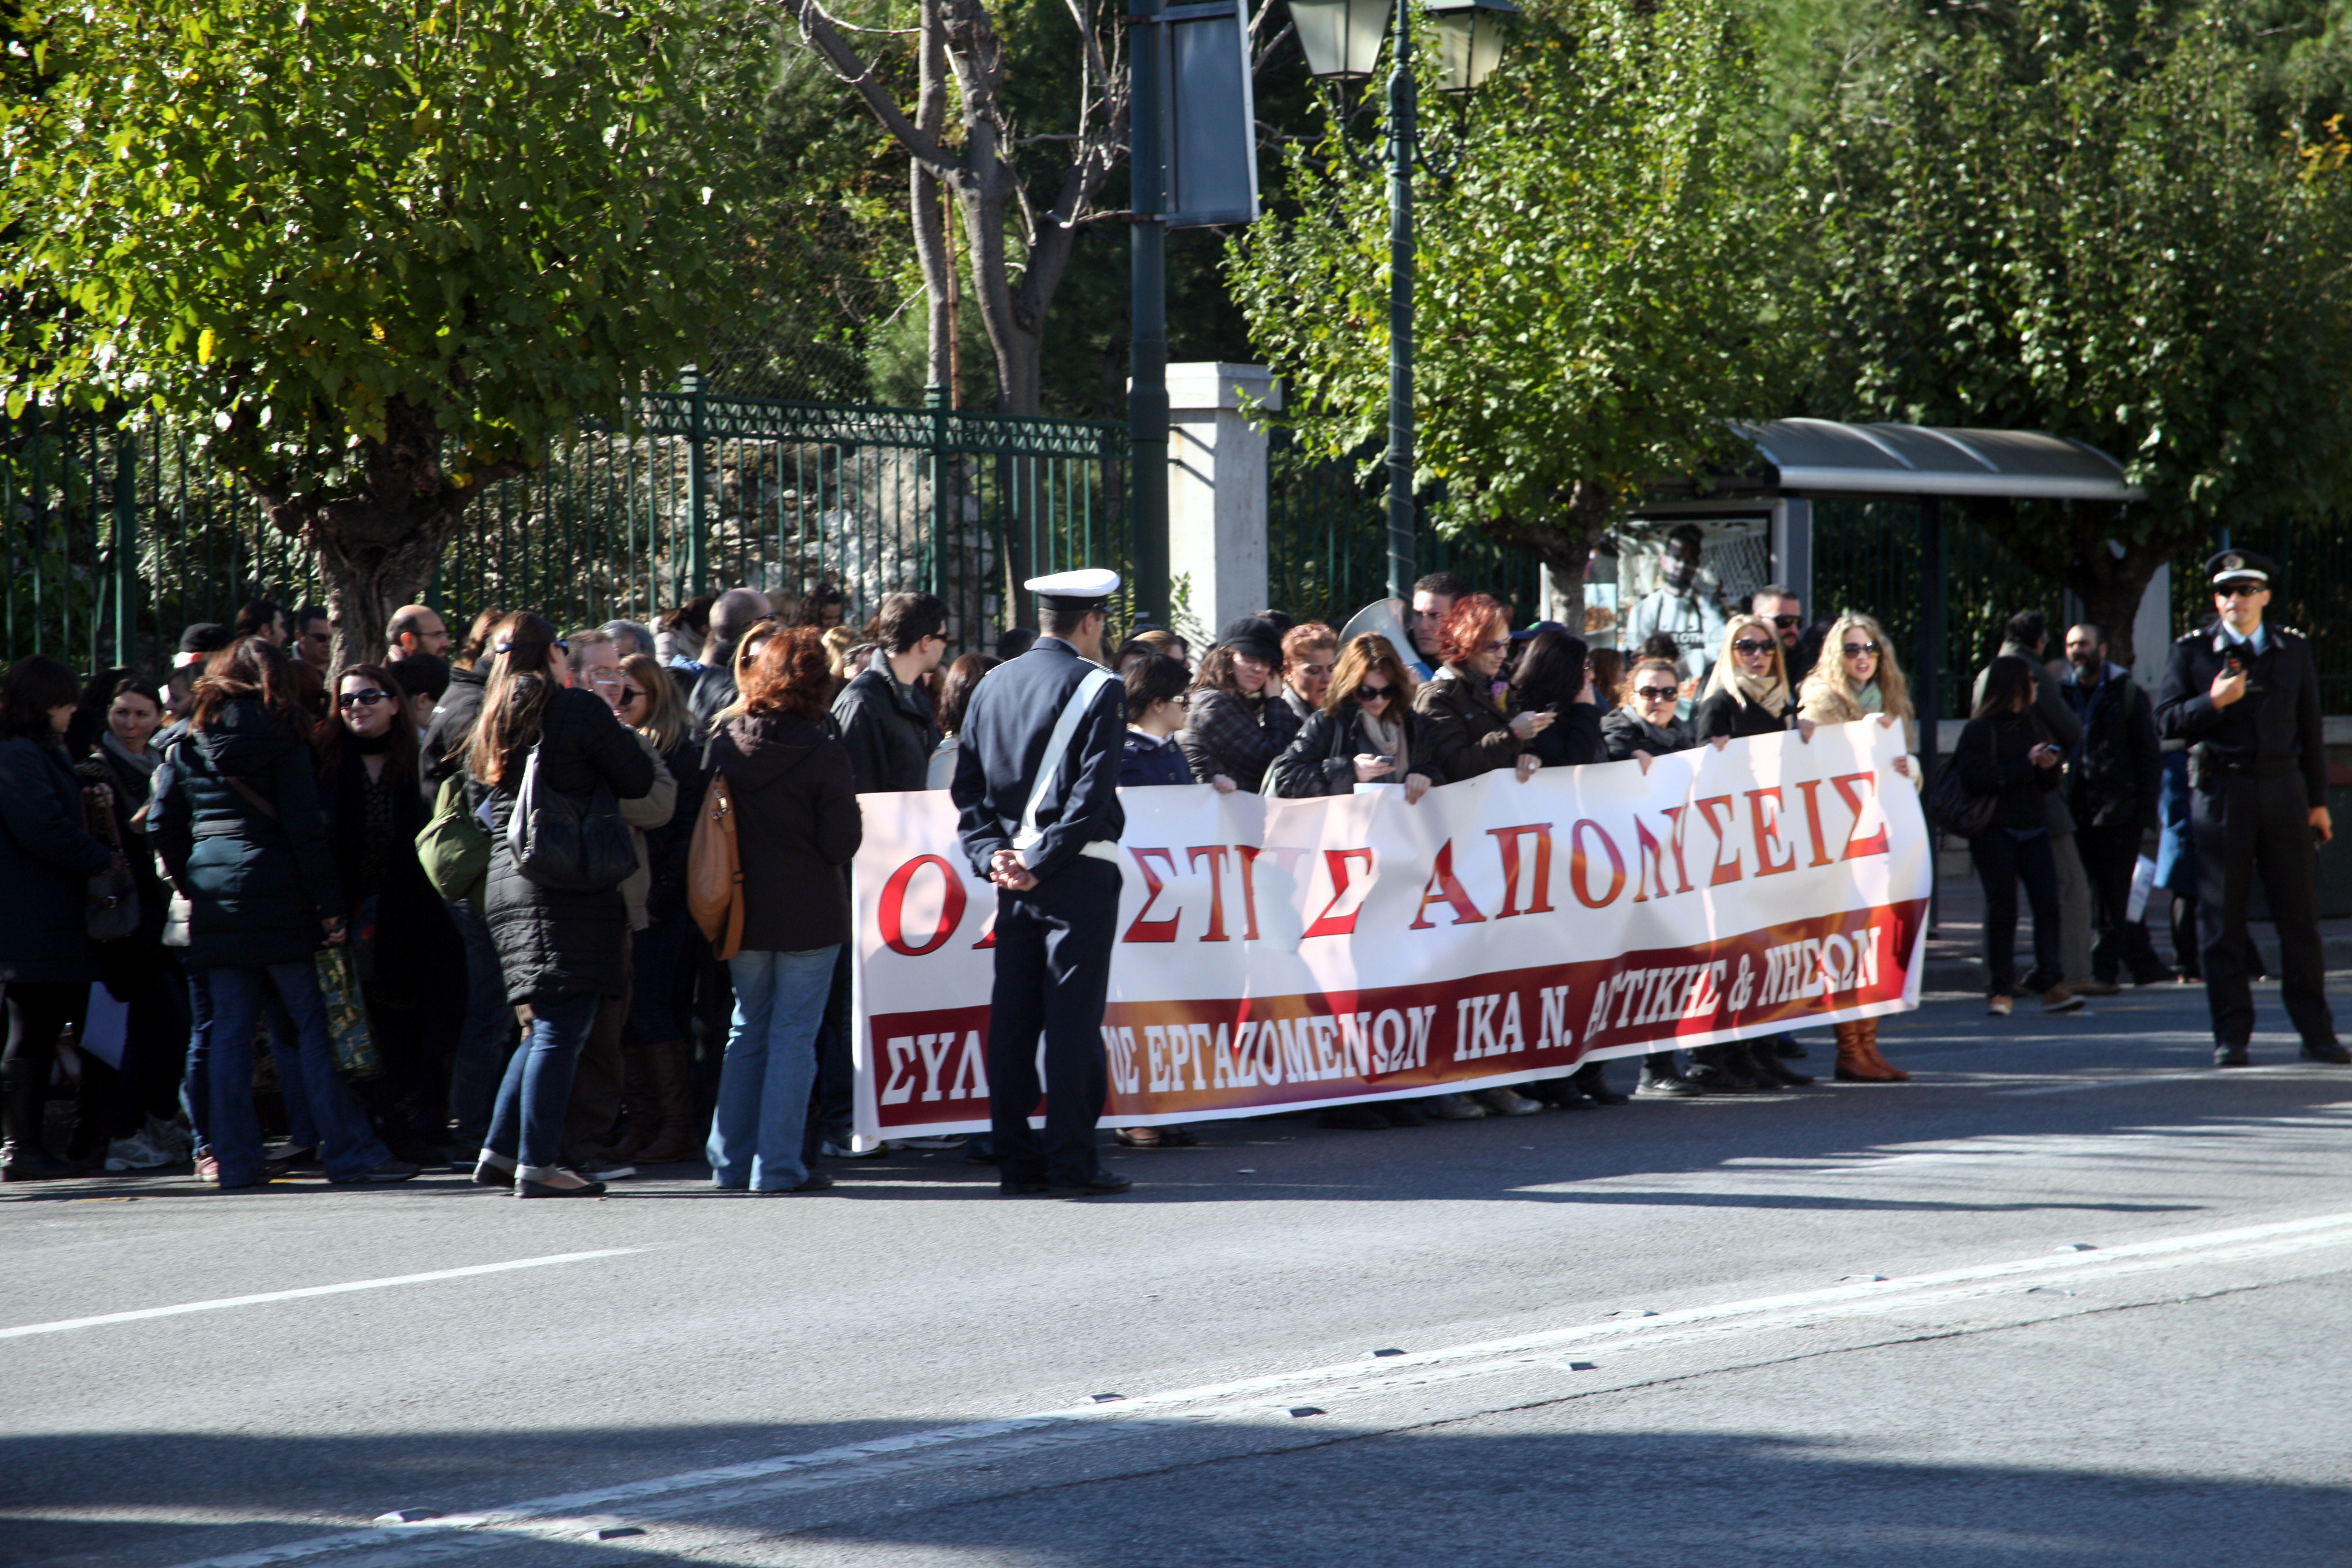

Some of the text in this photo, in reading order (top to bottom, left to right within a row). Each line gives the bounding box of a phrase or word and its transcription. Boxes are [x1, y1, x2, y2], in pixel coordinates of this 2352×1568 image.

[1409, 771, 1890, 930] ΑΠΟΛΥΣΕΙΣ
[1144, 1004, 1437, 1093] ΕΡΓΑΖΟΜΕΝΩΝ
[1453, 990, 1526, 1062] ΙΚΑ
[1536, 985, 1573, 1050] Ν.
[1728, 953, 1755, 1013] &
[1757, 926, 1881, 1008] ΝΗΣΩΝ
